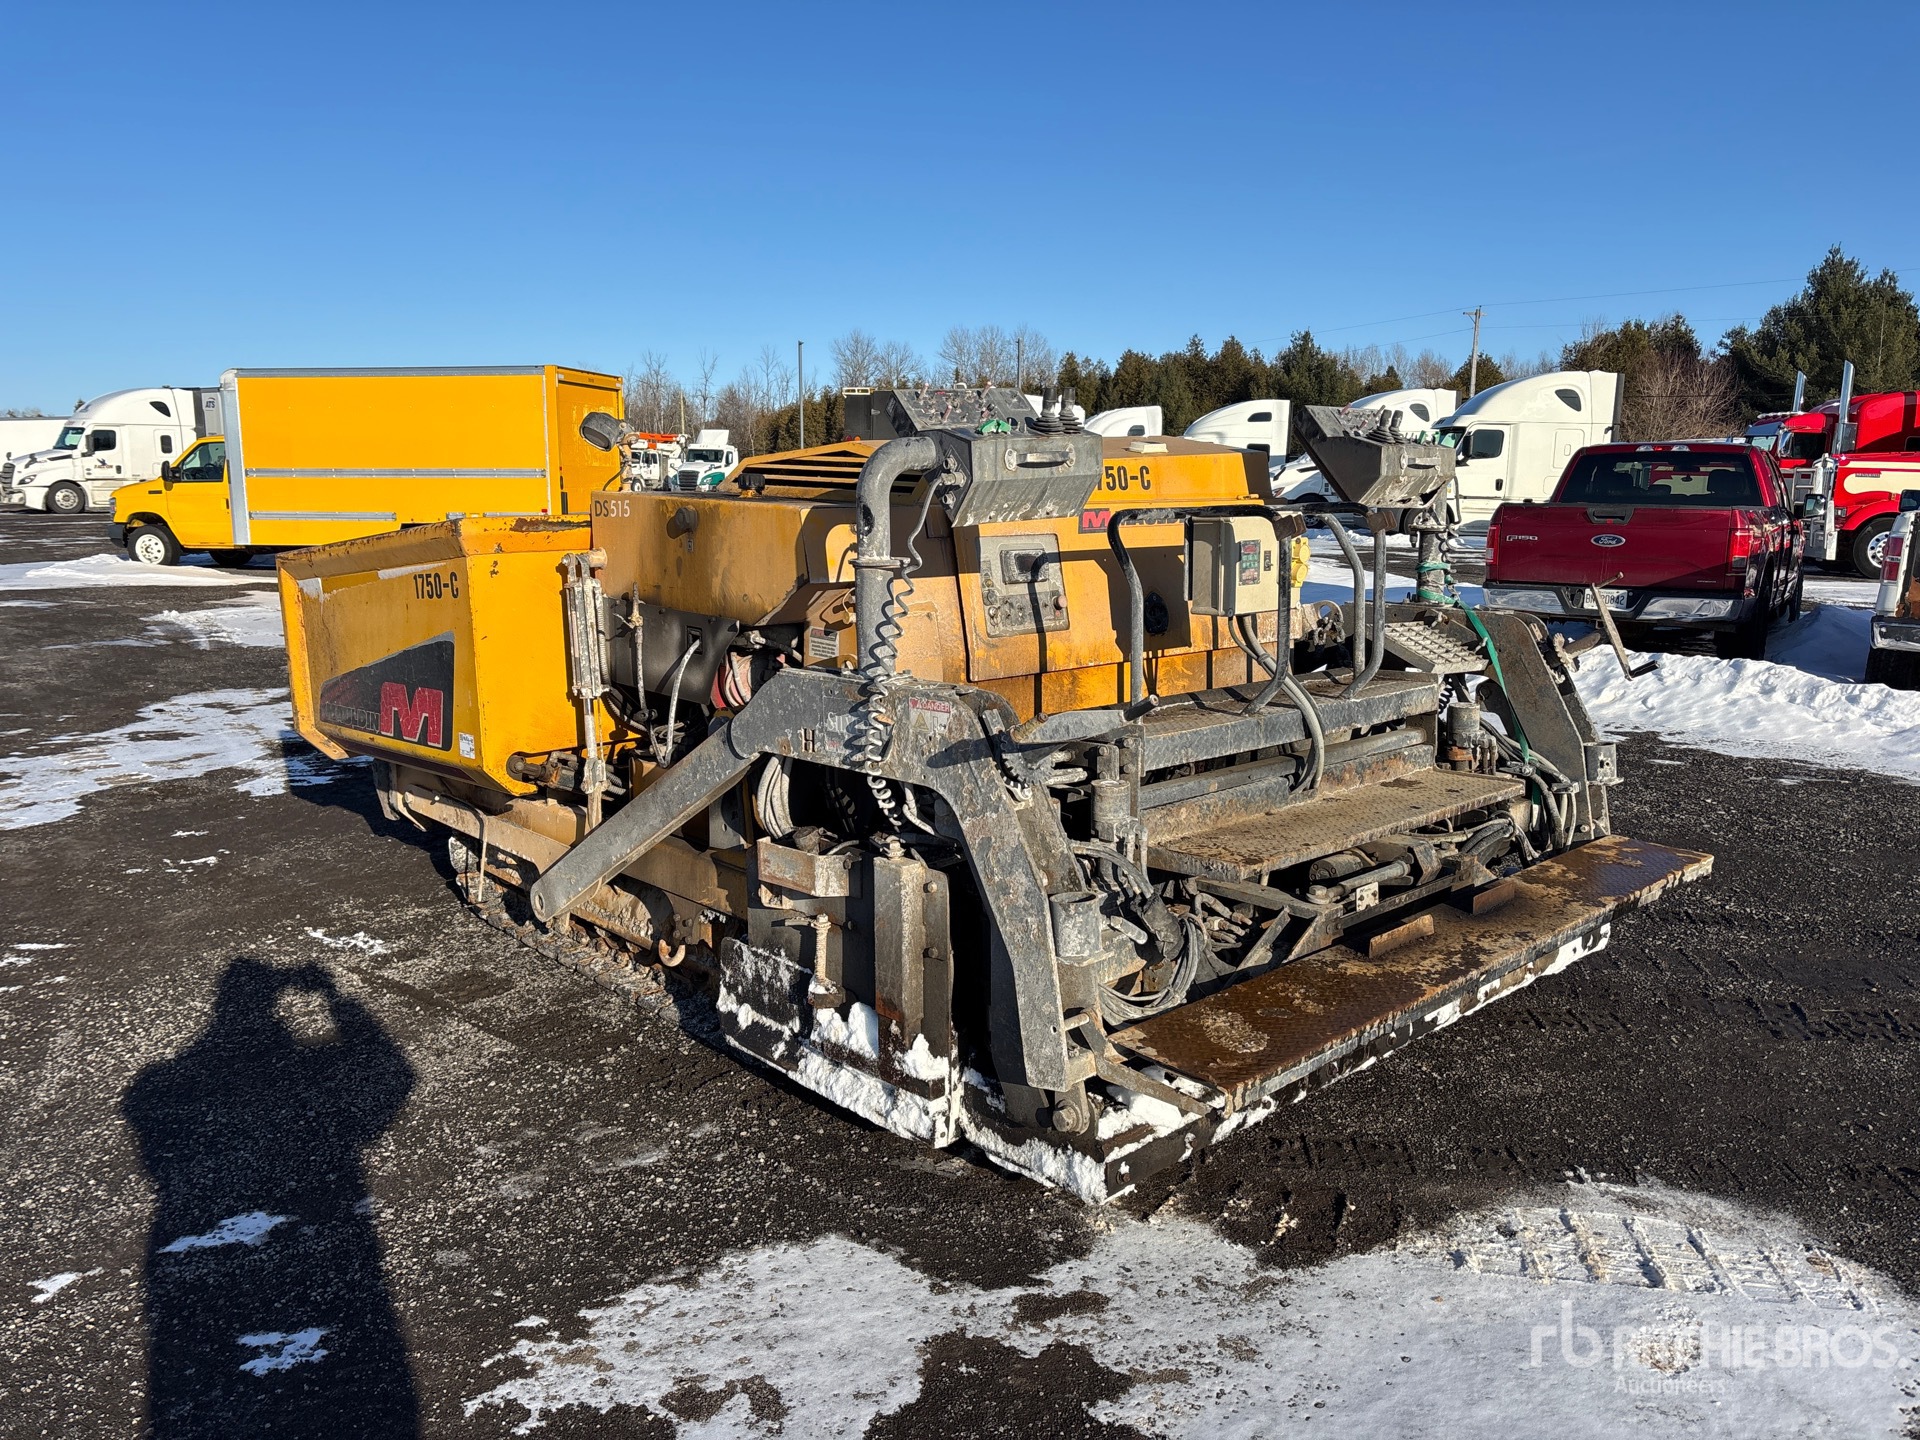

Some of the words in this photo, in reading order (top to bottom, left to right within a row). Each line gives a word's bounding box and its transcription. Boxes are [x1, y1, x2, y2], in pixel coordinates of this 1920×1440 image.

[594, 499, 630, 517] DS515
[1599, 536, 1617, 545] Ford
[413, 571, 459, 599] 1750-C
[380, 681, 443, 748] M
[921, 701, 950, 713] DANGER
